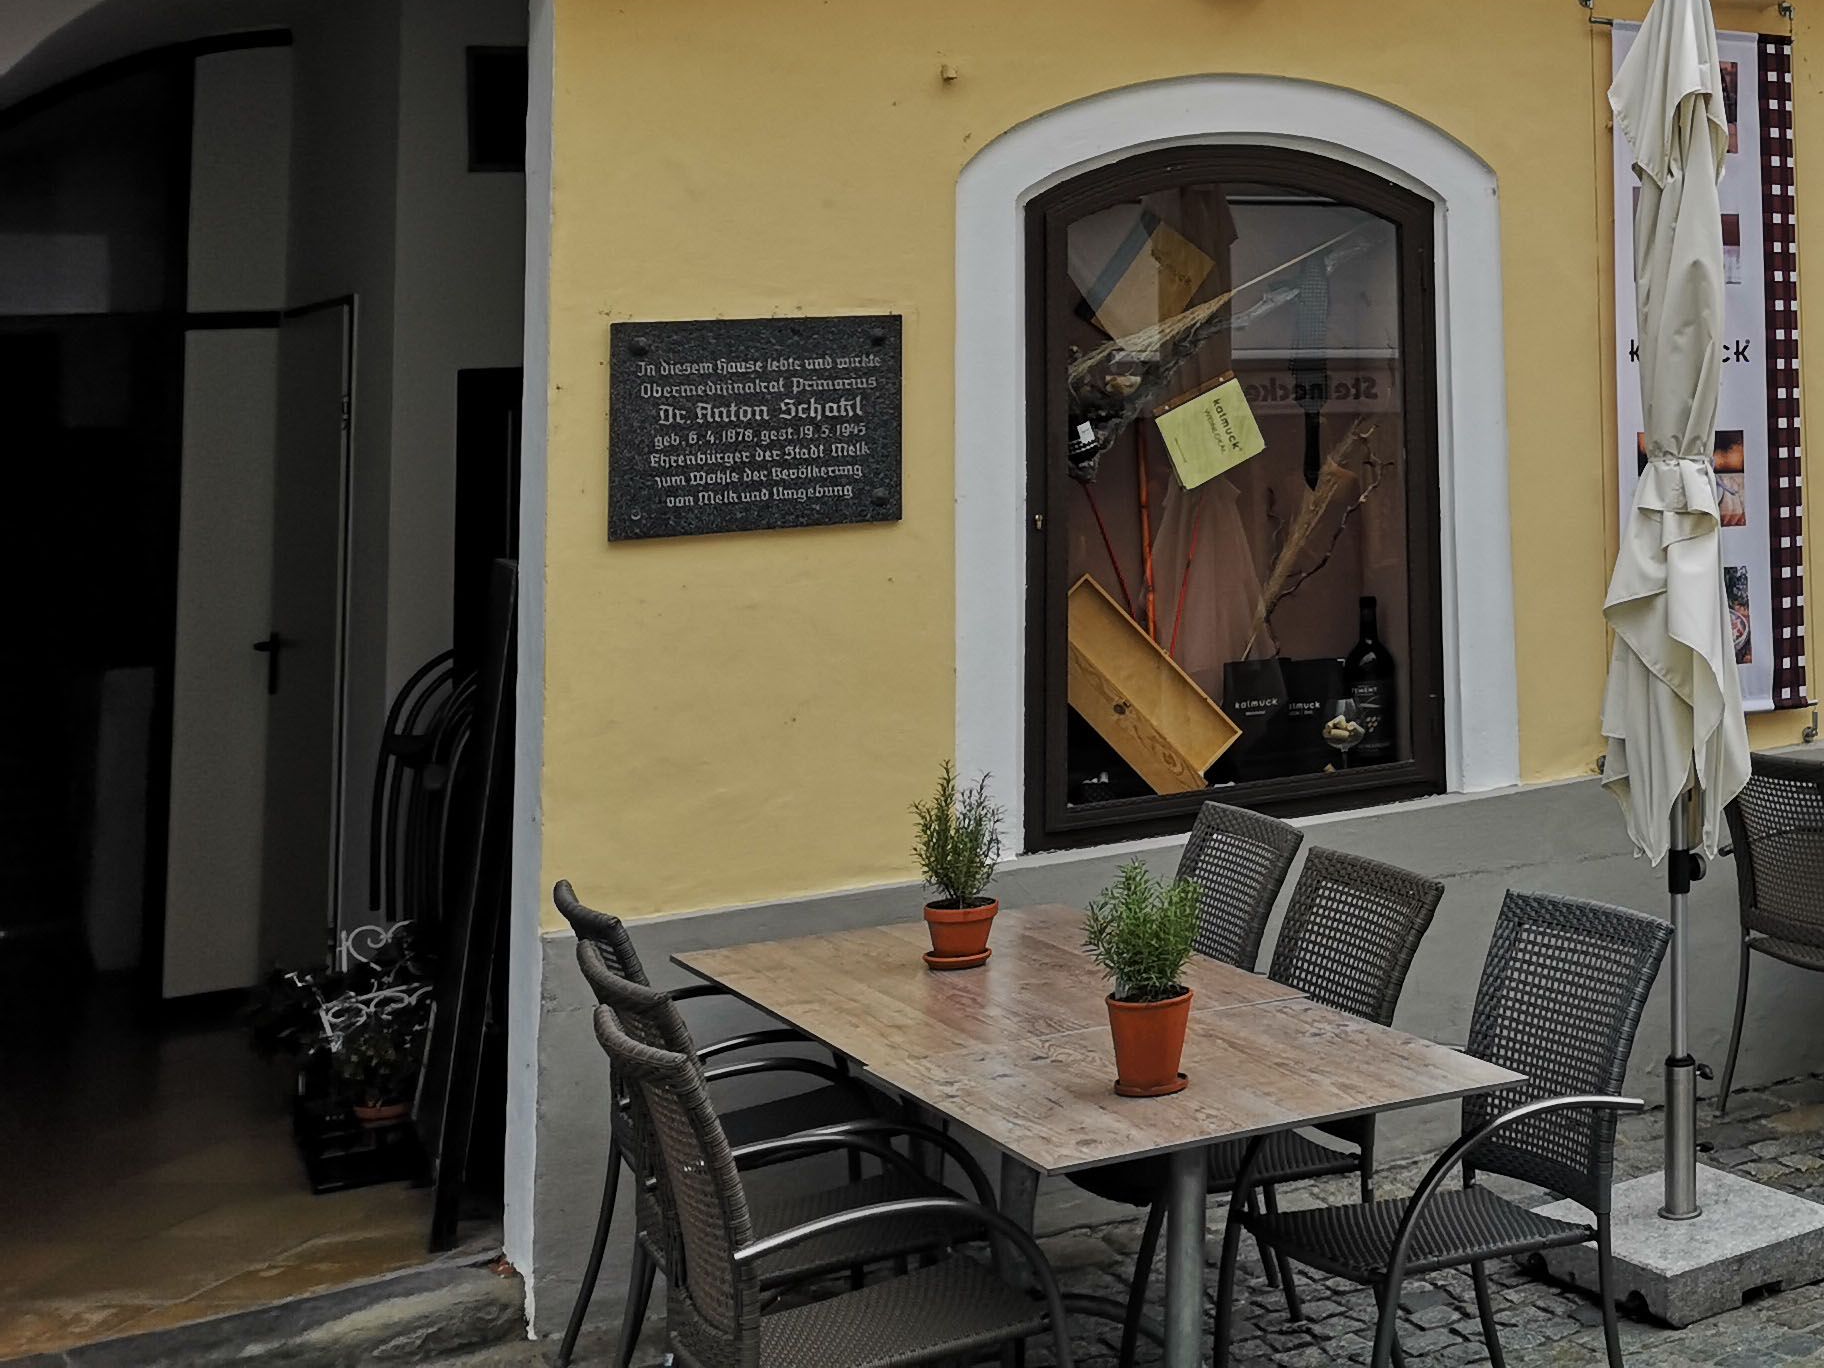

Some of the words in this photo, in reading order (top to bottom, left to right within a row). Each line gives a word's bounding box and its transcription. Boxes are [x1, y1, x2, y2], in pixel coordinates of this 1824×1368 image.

[637, 361, 656, 376] In
[660, 359, 713, 375] diesem
[717, 358, 763, 374] Hause
[767, 357, 802, 371] lebte
[804, 354, 833, 369] und
[836, 353, 881, 368] wirkte
[641, 377, 785, 399] Obermedizinalrat
[791, 374, 878, 395] Primarius
[658, 404, 691, 425] Dr.
[695, 400, 771, 423] Anton
[650, 450, 750, 468] Ehrenbürger
[755, 447, 781, 461] der
[784, 444, 824, 460] Stadt
[831, 441, 871, 457] Melk
[654, 475, 687, 489] zum
[689, 470, 740, 485] Wohle
[743, 467, 768, 482] der
[771, 464, 863, 481] Bevölkerung
[666, 495, 694, 508] von
[698, 489, 739, 506] Melk
[741, 488, 769, 502] und
[773, 484, 854, 503] Umgebung
